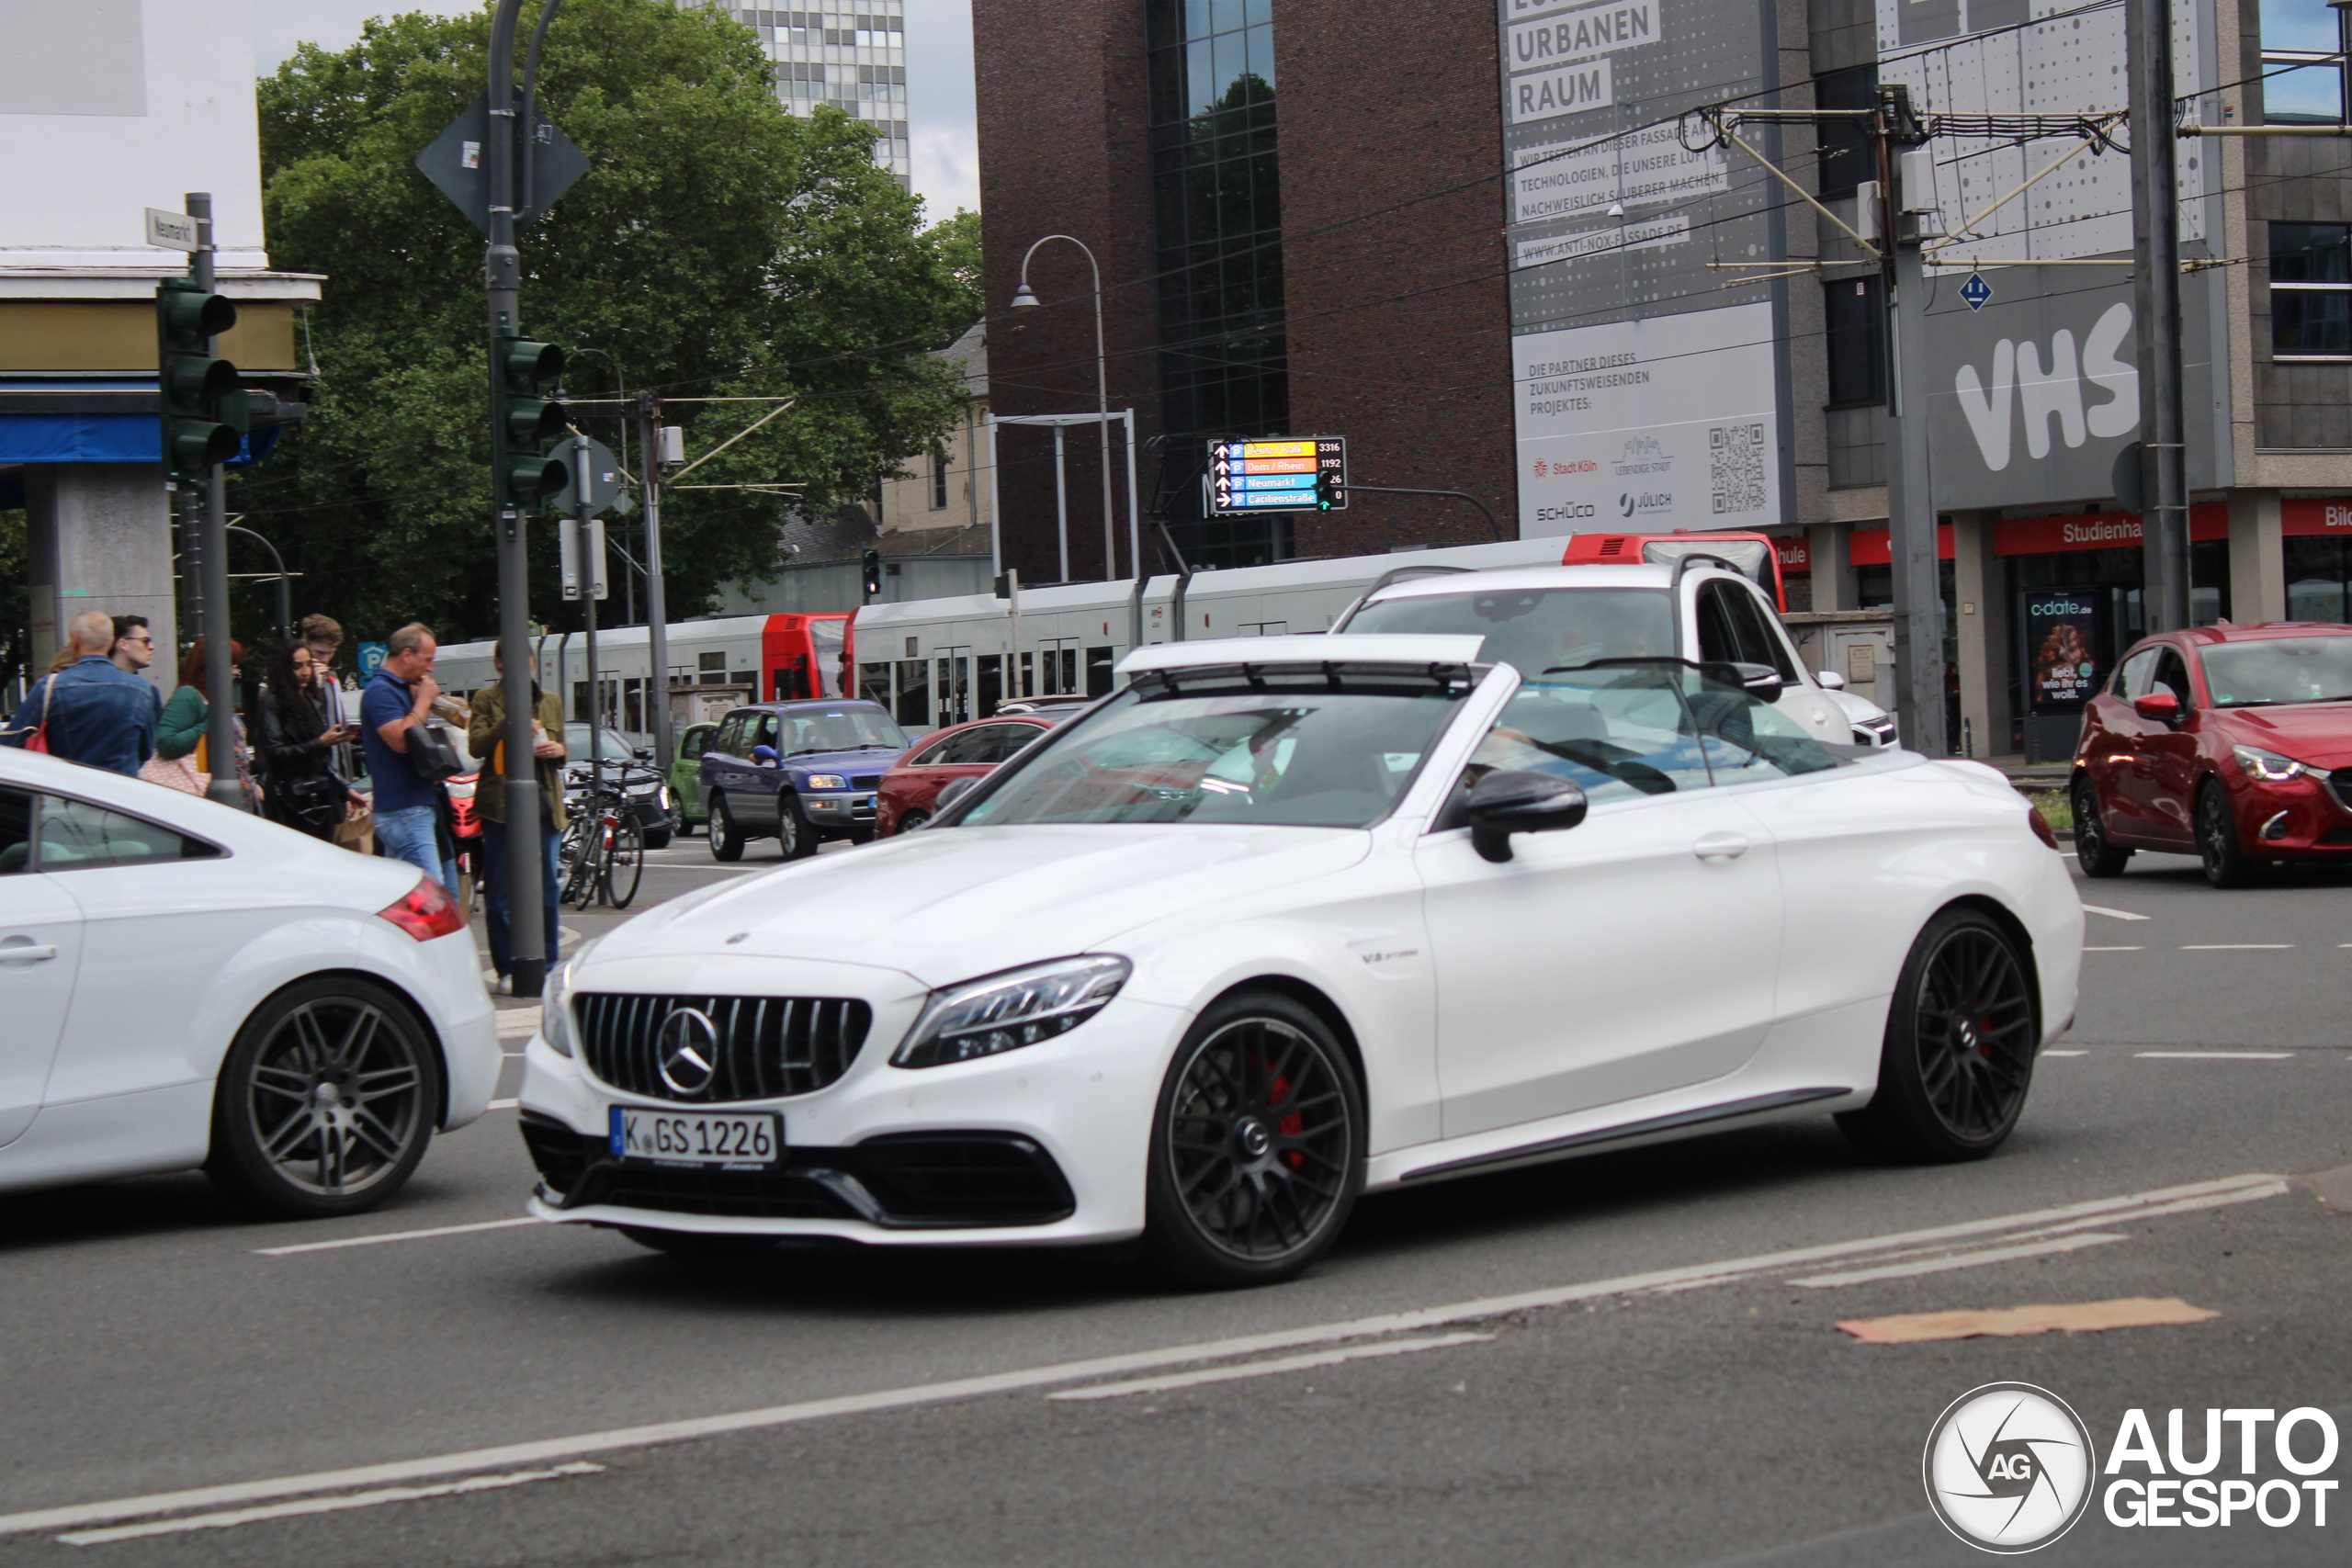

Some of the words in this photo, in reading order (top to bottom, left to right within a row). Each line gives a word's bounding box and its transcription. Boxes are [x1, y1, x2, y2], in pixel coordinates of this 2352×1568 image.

[1517, 6, 1648, 62] URBANEN
[1519, 70, 1600, 115] RAUM
[1520, 152, 1540, 166] WIR
[1543, 144, 1581, 164] TESTEN
[1583, 141, 1599, 156] AN
[1601, 135, 1638, 153] DIESER
[1521, 166, 1609, 192] TECHNOLOGIEN,
[1633, 152, 1677, 173] UNSERE
[1521, 191, 1605, 217] NACHWEISLICH
[1669, 172, 1724, 192] MACHEN.
[1523, 224, 1682, 260] WWW.ANTI-NOX-FASSADE.DE
[1529, 364, 1546, 377] DIE
[1548, 357, 1597, 375] PARTNER
[1600, 353, 1635, 369] DIESES
[1530, 370, 1650, 396] ZUKUNFTSWEISENDEN
[1955, 302, 2140, 471] VHS
[1531, 397, 1592, 416] PROJEKTES:
[1247, 445, 1273, 455] Deutz
[1283, 444, 1303, 454] Kalk
[1318, 443, 1340, 453] 3316
[1247, 462, 1271, 472] Dom
[1278, 461, 1305, 470] Rhein
[1321, 458, 1341, 468] 1192
[1553, 461, 1577, 475] Stadt
[1577, 459, 1598, 473] Köln
[1248, 477, 1295, 488] Neumarkt
[1335, 491, 1342, 500] 0
[1637, 491, 1671, 508] JÜLICH
[1537, 502, 1594, 521] SCHÜCO
[2064, 519, 2143, 543] Studienha
[2031, 600, 2093, 616] c-date.de
[2052, 667, 2078, 679] liebt,
[2042, 679, 2061, 689] wie
[2062, 678, 2075, 688] ihr
[2075, 679, 2088, 688] es
[2052, 689, 2079, 699] wollt.
[625, 1116, 640, 1151] K
